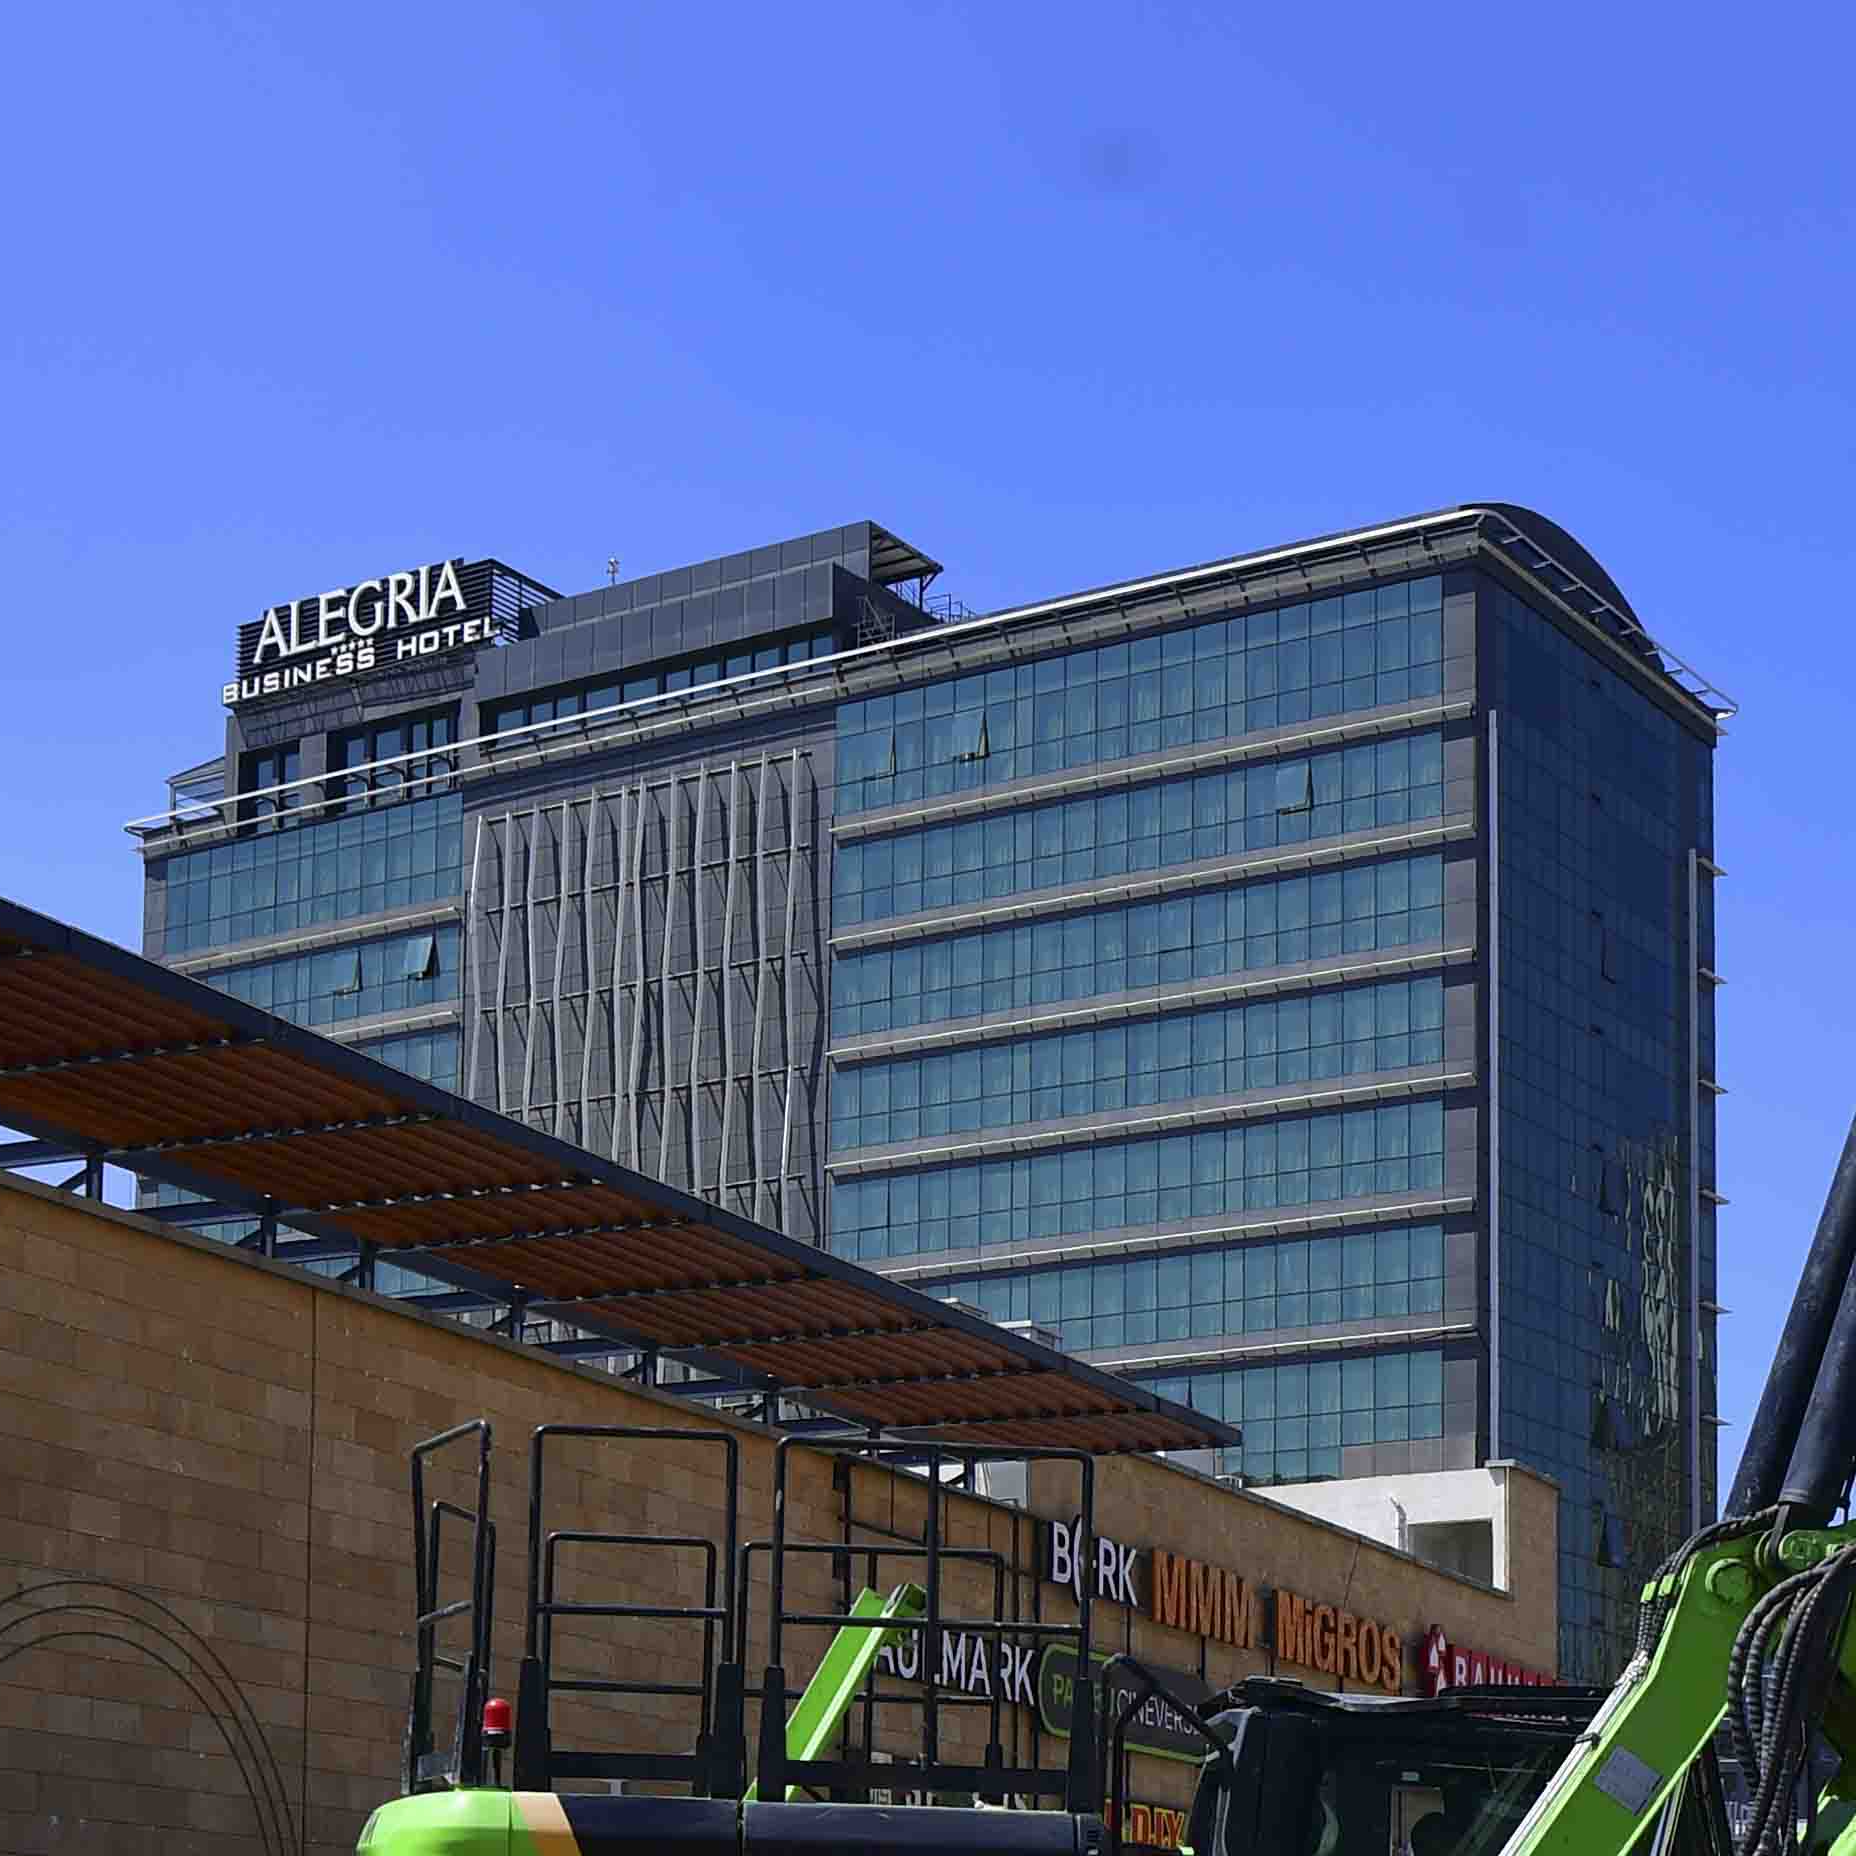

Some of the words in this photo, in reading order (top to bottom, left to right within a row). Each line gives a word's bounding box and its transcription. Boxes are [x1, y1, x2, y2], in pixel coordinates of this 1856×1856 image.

[222, 647, 376, 706] BUSINESS
[396, 616, 502, 662] HOTEL
[253, 559, 468, 665] ALEGRIA
[1152, 1548, 1257, 1650] MMM
